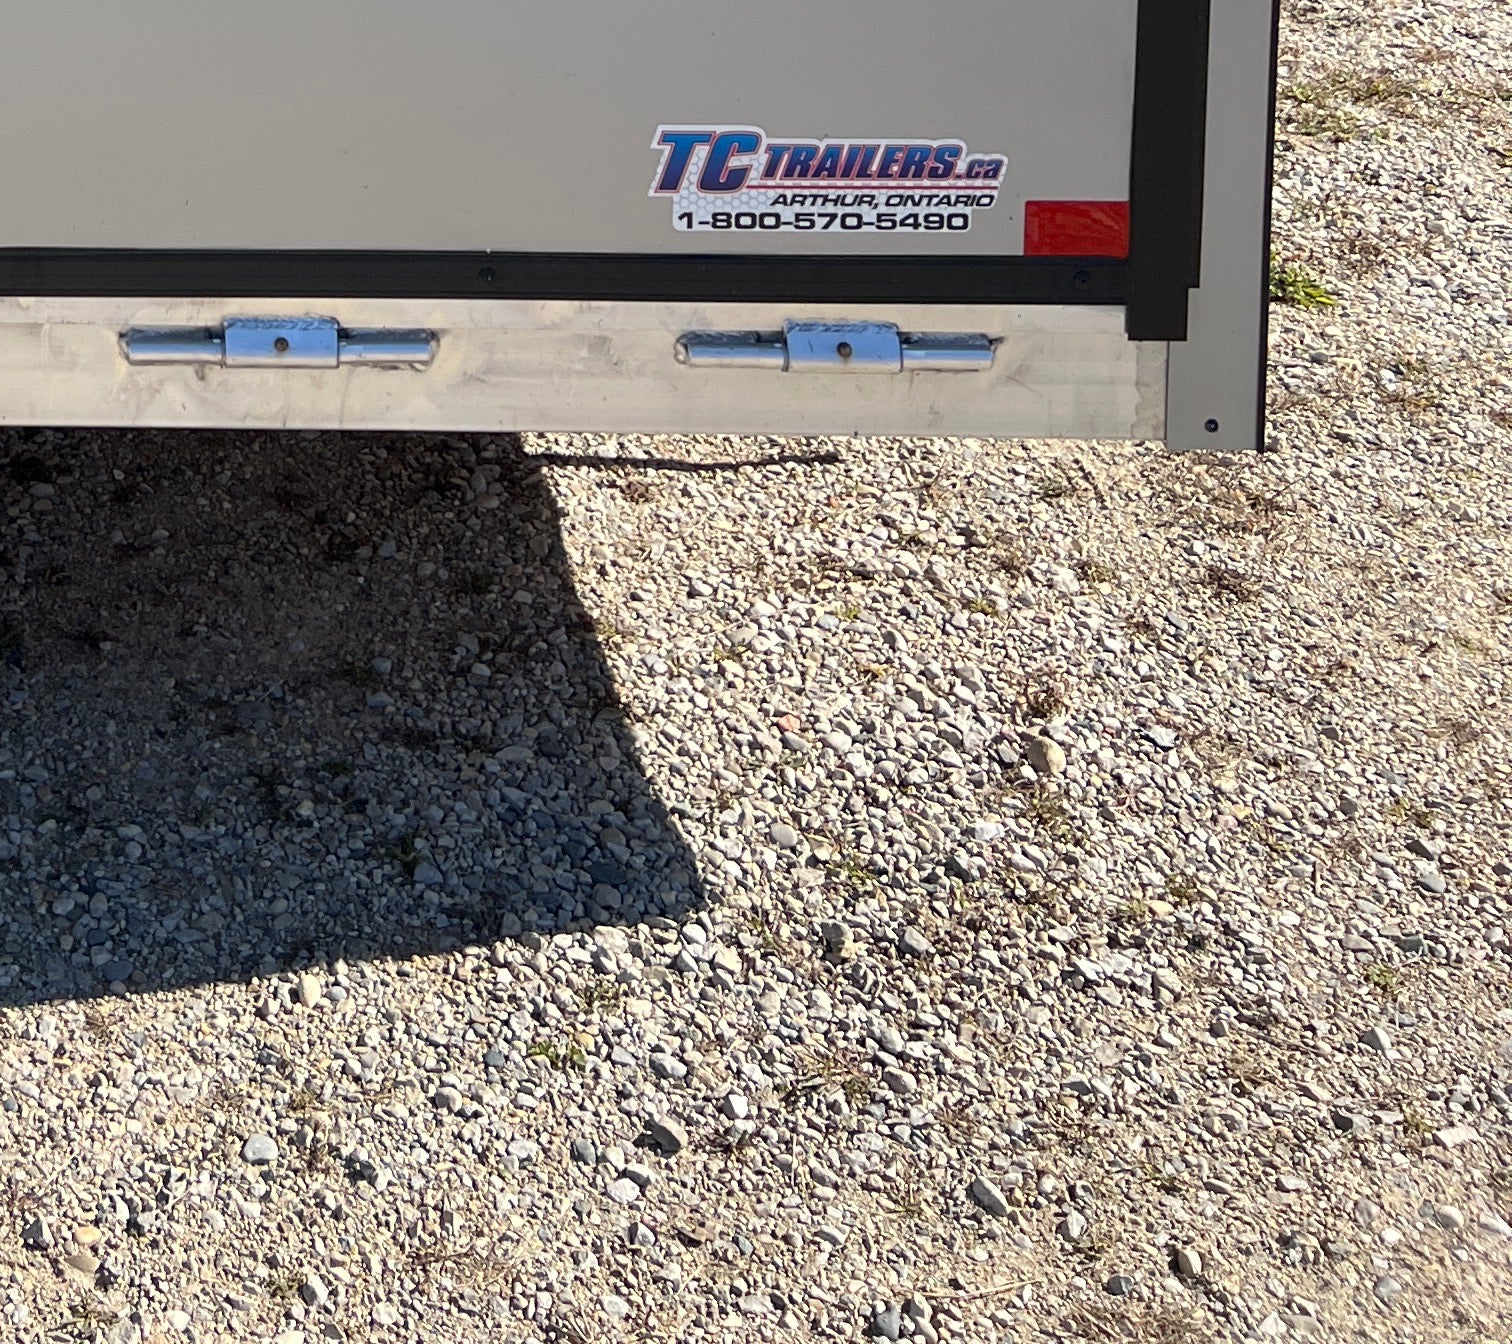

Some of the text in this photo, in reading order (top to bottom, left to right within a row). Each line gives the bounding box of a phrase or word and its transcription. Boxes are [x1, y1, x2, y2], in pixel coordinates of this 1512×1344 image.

[655, 131, 1005, 194] TC TRAILERS.ca
[769, 193, 995, 211] ARTHUR, ONTARIO
[676, 211, 970, 231] 1-800-570-5490
